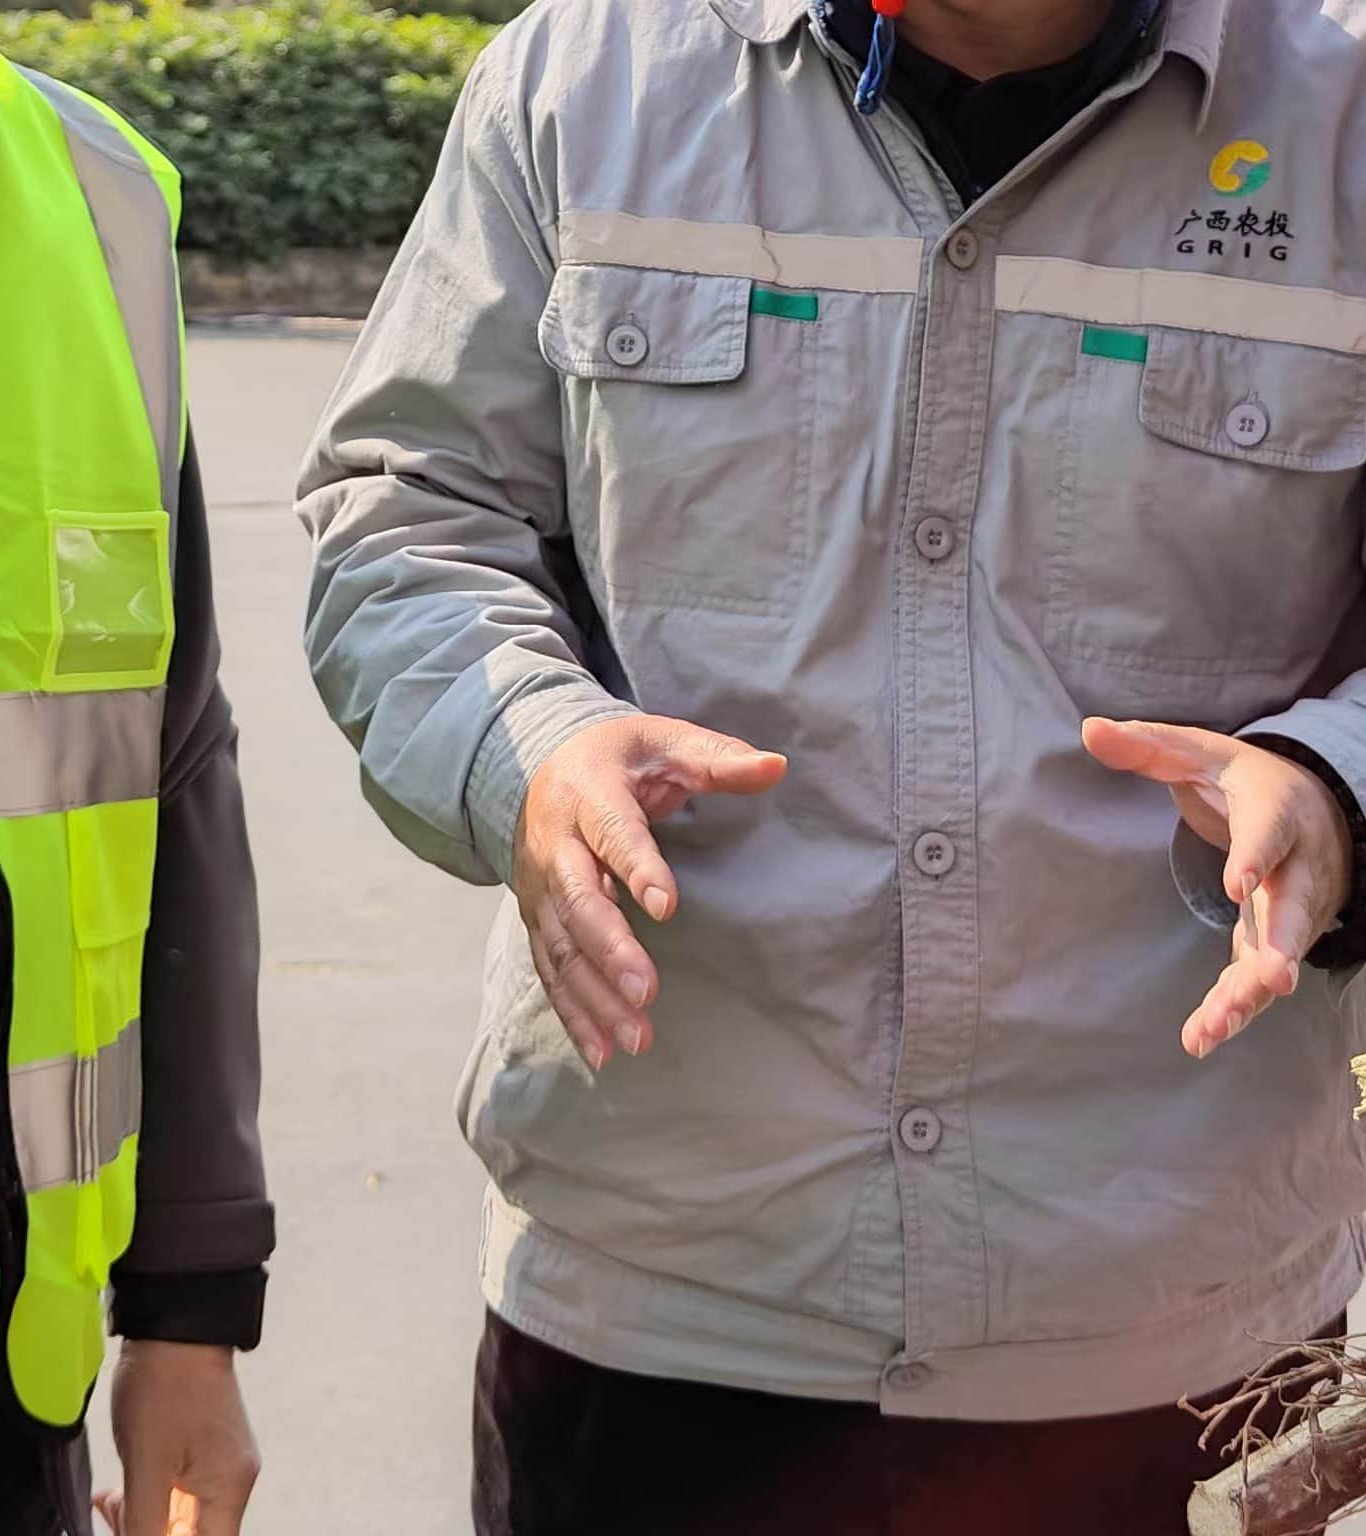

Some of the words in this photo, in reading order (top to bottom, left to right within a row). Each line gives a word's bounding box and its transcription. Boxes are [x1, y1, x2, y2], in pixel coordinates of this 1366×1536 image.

[1174, 206, 1295, 239] 广西农投
[1176, 239, 1289, 262] GRIG
